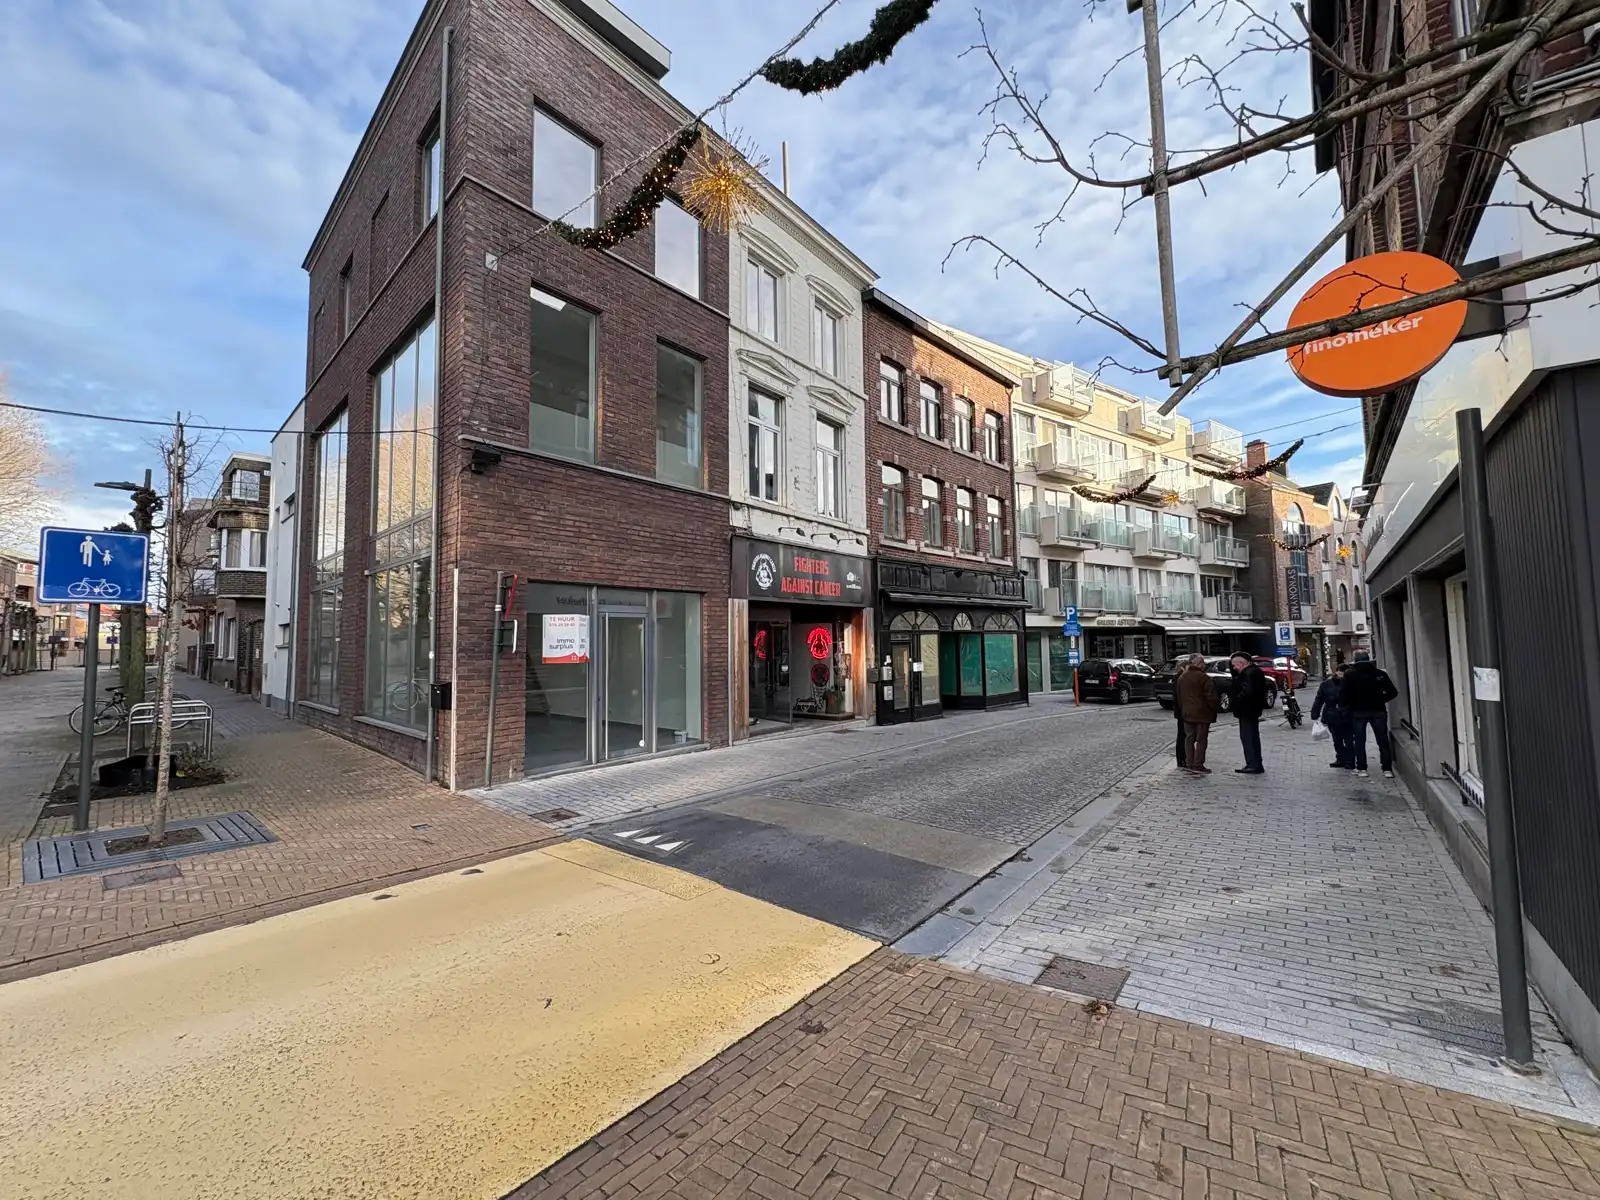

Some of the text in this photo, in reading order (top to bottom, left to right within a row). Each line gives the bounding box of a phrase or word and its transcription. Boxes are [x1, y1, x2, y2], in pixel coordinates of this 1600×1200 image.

[793, 556, 829, 575] FIGHTERS
[781, 576, 814, 595] AGAINST
[814, 579, 841, 597] CANCER
[1288, 569, 1300, 619] SYNONYME
[1066, 607, 1075, 620] P
